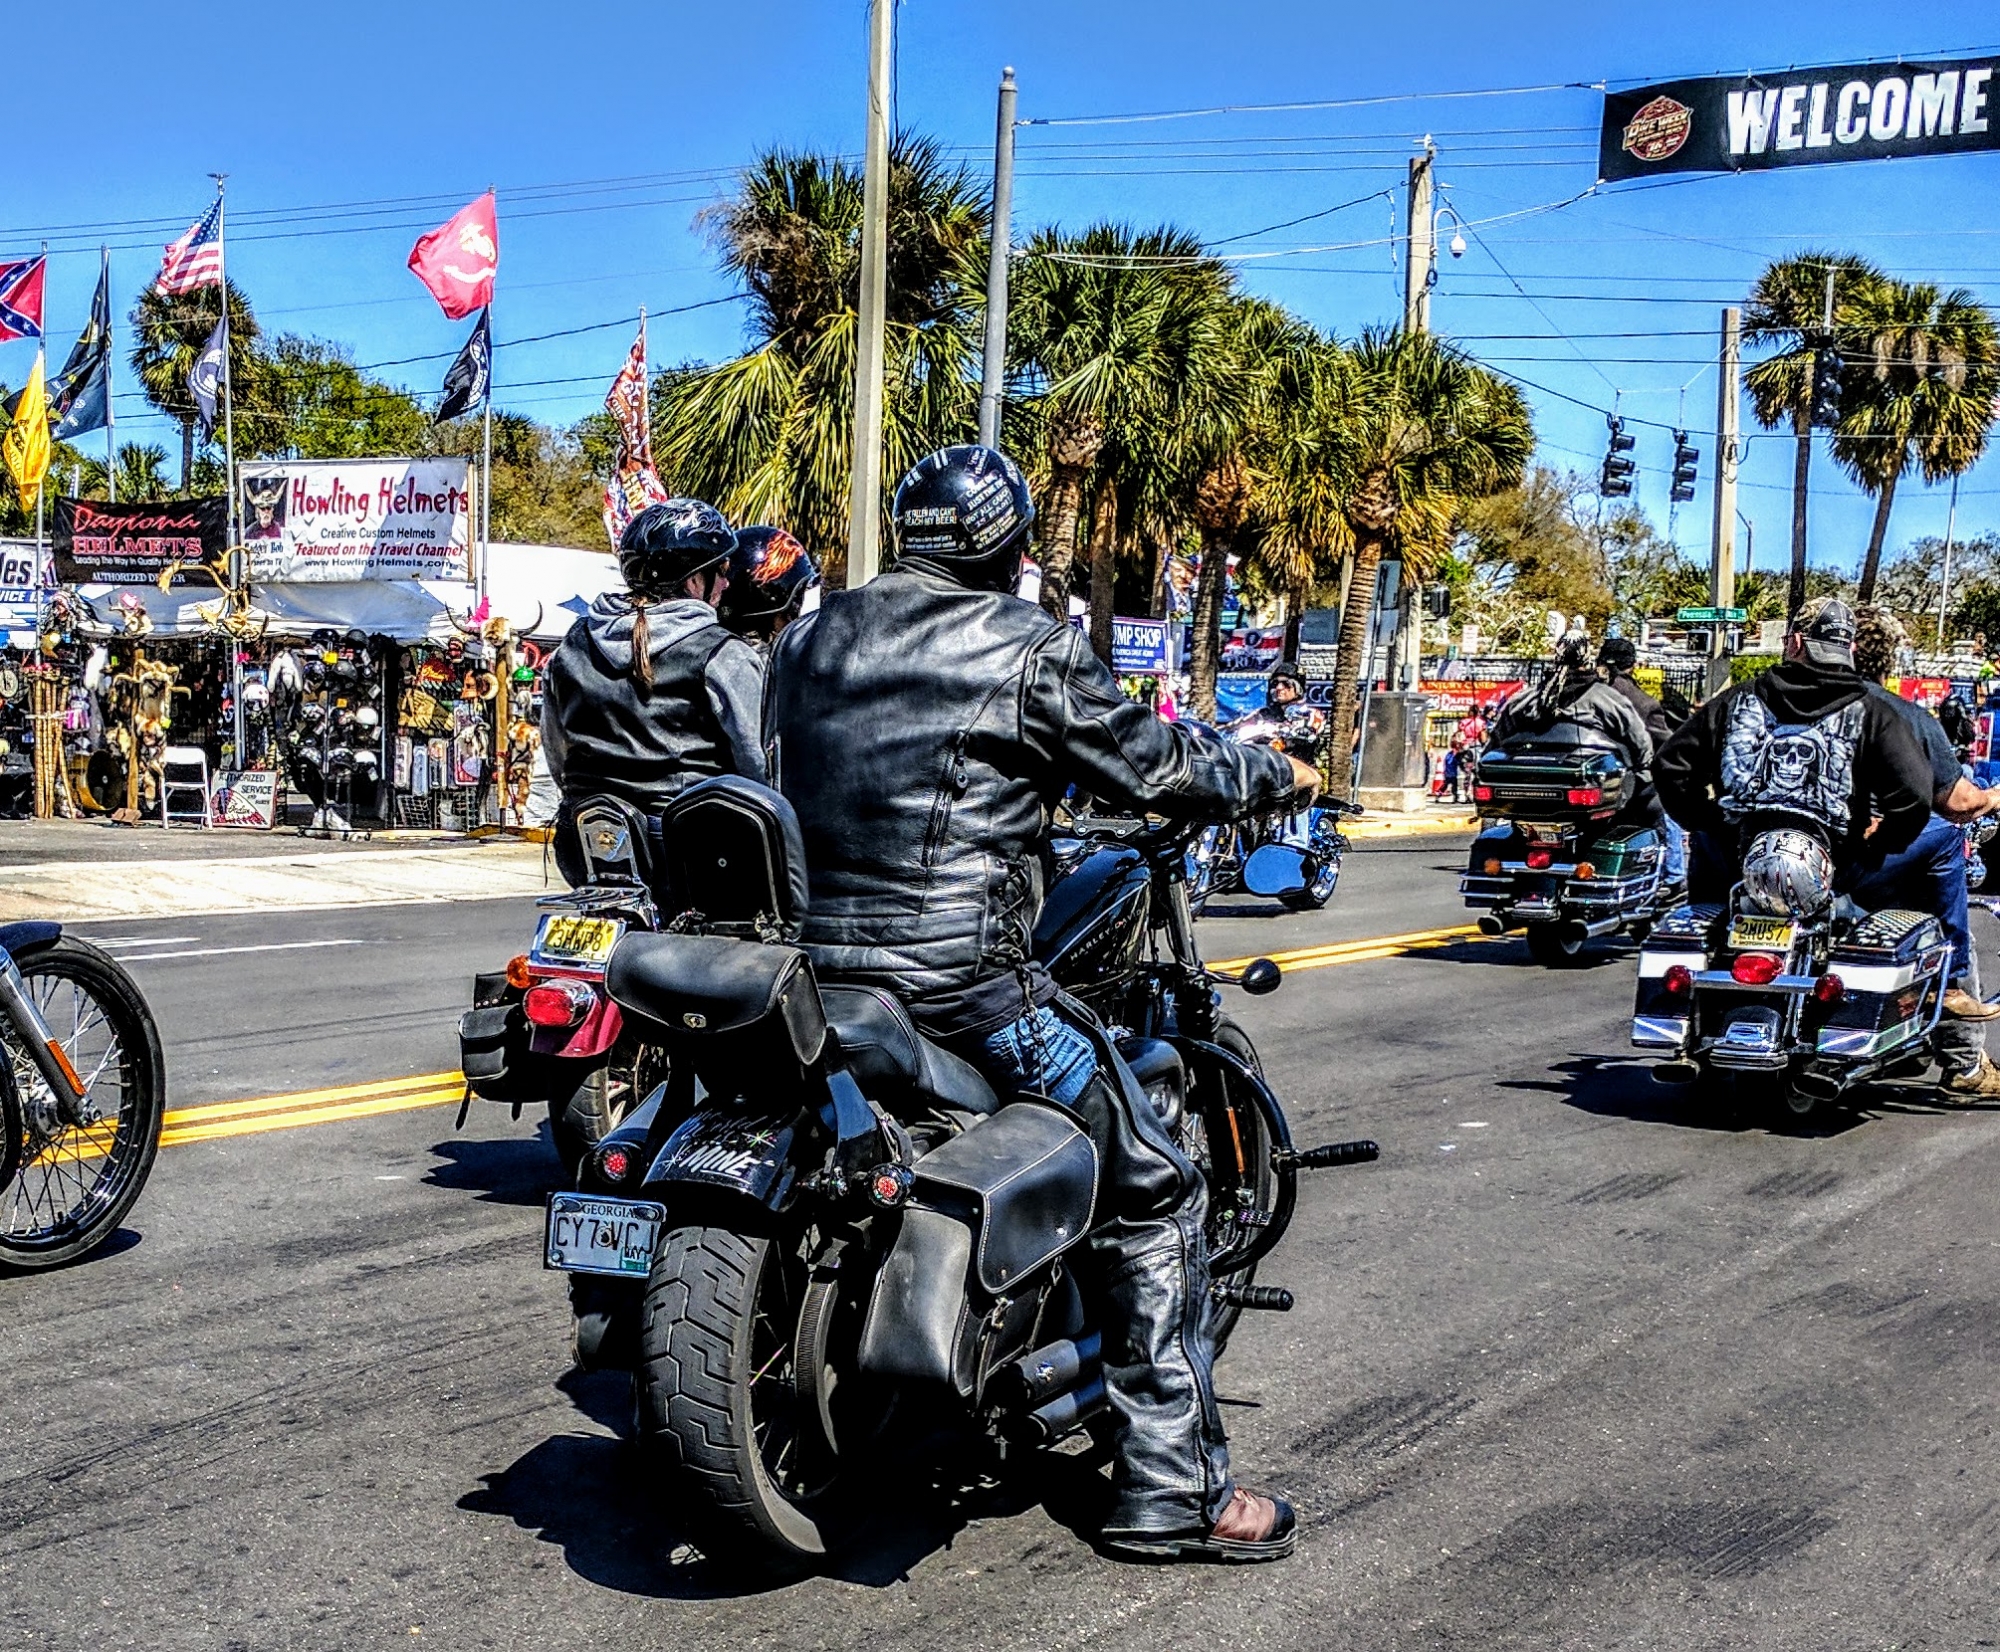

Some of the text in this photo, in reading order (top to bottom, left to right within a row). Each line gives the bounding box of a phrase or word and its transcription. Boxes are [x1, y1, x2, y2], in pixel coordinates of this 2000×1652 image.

[1727, 68, 1992, 155] WELCOME
[292, 475, 469, 523] Howling Helmets
[924, 517, 935, 525] MY
[935, 515, 957, 525] BEER!
[929, 507, 939, 517] AND
[74, 505, 201, 540] Daytona
[320, 527, 436, 539] Creative Custom Helmets
[72, 536, 203, 557] HELMETS
[342, 545, 355, 556] on
[359, 542, 377, 556] the
[379, 542, 414, 556] Travel
[113, 556, 128, 567] Way
[92, 572, 147, 582] AUTHORIZED
[1134, 626, 1161, 648] SHOP
[219, 771, 273, 795] AUTHORIZED SERVICE
[679, 1145, 761, 1176] MINE
[583, 1203, 635, 1218] GEORGIA
